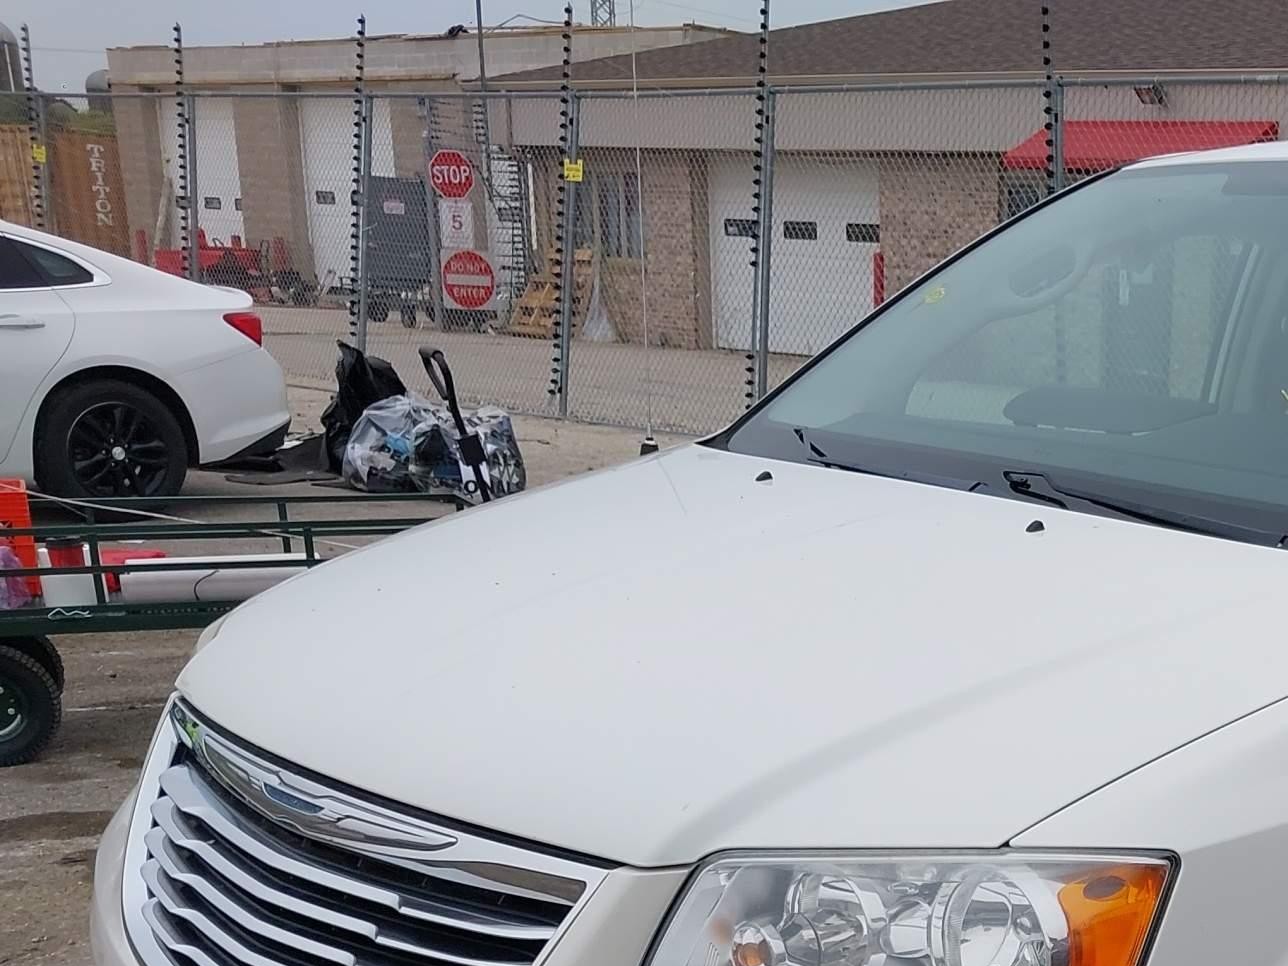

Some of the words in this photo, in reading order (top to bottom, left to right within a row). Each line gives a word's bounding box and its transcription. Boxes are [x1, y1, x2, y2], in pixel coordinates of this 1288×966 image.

[433, 165, 470, 184] STOP
[86, 144, 113, 226] TRITON
[452, 214, 463, 231] 5
[451, 261, 464, 272] DO
[467, 262, 487, 273] NOT
[453, 287, 487, 298] ENTER
